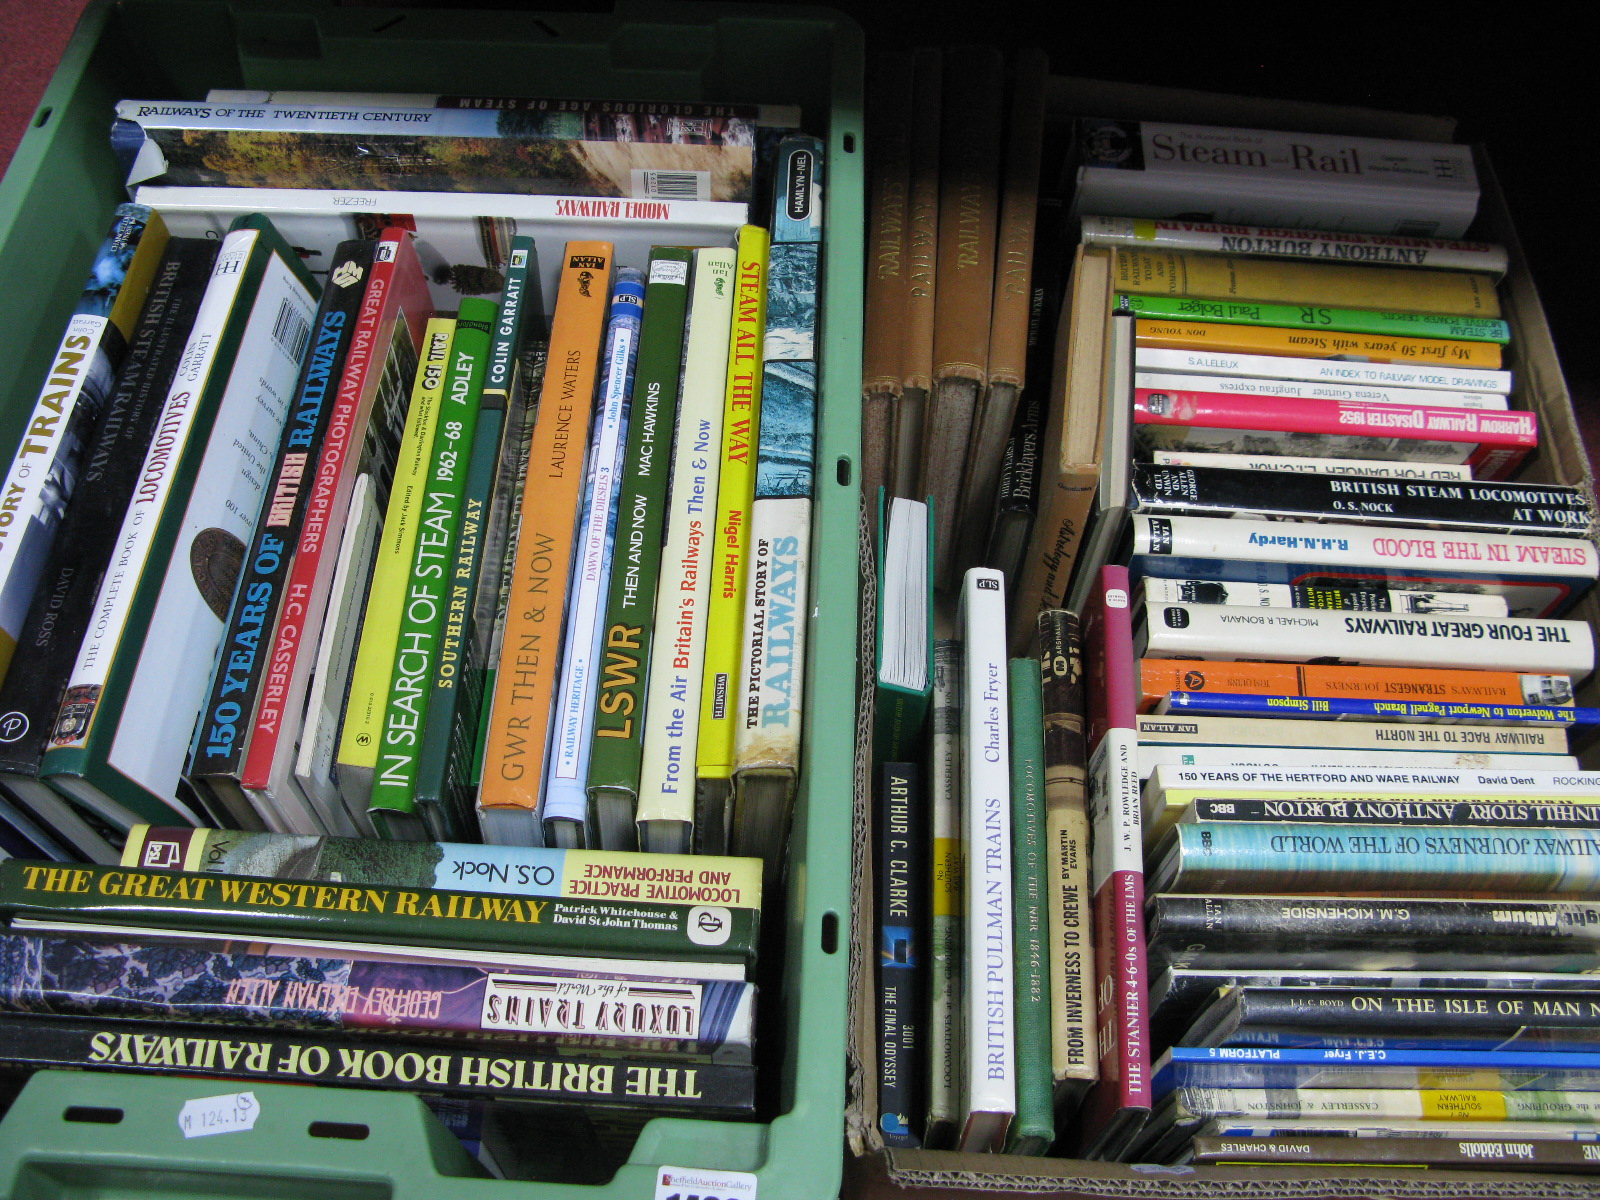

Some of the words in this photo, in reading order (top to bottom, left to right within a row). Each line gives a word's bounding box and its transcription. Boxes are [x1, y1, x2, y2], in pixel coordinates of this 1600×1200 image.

[137, 106, 212, 119] RAILWAYS
[215, 108, 236, 118] OF
[237, 109, 265, 119] THE
[273, 109, 359, 121] TWENTIETH
[362, 111, 432, 122] CENTURY
[794, 153, 807, 213] HAMLYN-NEL
[555, 200, 621, 219] RAILWAYS
[622, 200, 670, 220] MODEL
[1219, 236, 1313, 259] BURTON
[1318, 242, 1428, 267] ANTHONY
[361, 278, 385, 327] GREAT
[738, 261, 760, 323] STEAM
[734, 328, 755, 366] ALL
[1287, 334, 1328, 348] Steam
[1330, 339, 1359, 353] with
[1362, 340, 1397, 355] years
[1401, 344, 1417, 357] 50
[1420, 344, 1450, 360] first
[1451, 344, 1471, 360] My
[287, 309, 348, 449] RAILWAYS
[342, 331, 375, 402] RAILWAY
[19, 334, 91, 460] TRAINS
[730, 370, 754, 412] THE
[643, 382, 661, 444] HAWKINS
[1338, 409, 1367, 426] 1952
[1366, 410, 1425, 430] DISASTER
[1426, 413, 1479, 433] RAILWAY
[700, 419, 711, 452] Now
[1479, 417, 1536, 436] HARROW
[136, 390, 191, 505] LOCOMOTIVES
[436, 420, 463, 481] 1962-68
[727, 418, 750, 465] WAY
[18, 462, 32, 479] OF
[638, 445, 653, 476] MAC
[692, 452, 708, 470] &
[1012, 433, 1039, 500] Bricklayers
[302, 403, 353, 553] PHOTOGRAPHERS
[687, 474, 706, 515] Then
[1330, 480, 1400, 497] BRITISH
[1406, 483, 1463, 500] STEAM
[1468, 487, 1590, 507] LOCOMOTIVES
[133, 508, 145, 526] OF
[632, 494, 648, 529] NOW
[414, 491, 456, 580] STEAM
[626, 530, 643, 563] AND
[757, 538, 769, 557] OF
[1248, 531, 1349, 551] R.H.N.Hardy
[1371, 537, 1436, 559] BLOOD
[119, 531, 138, 567] BOOK
[253, 533, 285, 575] OF
[680, 520, 702, 592] Railways
[1442, 540, 1483, 561] THE
[1487, 543, 1510, 563] IN
[1516, 545, 1587, 567] STEAM
[528, 532, 556, 594] NOW
[438, 585, 468, 689] SOUTHERN
[456, 497, 483, 581] RAILWAY
[622, 566, 640, 609] THEN
[754, 559, 767, 607] STORY
[93, 570, 124, 640] COMPLETE
[408, 585, 439, 624] OF
[523, 605, 546, 623] &
[220, 581, 273, 698] YEARS
[672, 596, 694, 670] Britain's
[761, 536, 799, 730] RAILWAYS
[1344, 617, 1428, 638] RAILWAYS
[1431, 620, 1485, 639] GREAT
[1486, 623, 1532, 641] FOUR
[1536, 625, 1571, 642] THE
[83, 642, 100, 670] THE
[749, 609, 765, 693] PICTORIAL
[510, 633, 541, 705] THEN
[596, 623, 642, 740] LSWR
[386, 631, 432, 746] SEARCH
[569, 664, 584, 713] HERITAGE
[671, 675, 688, 703] Air
[715, 675, 726, 718] WHSMITH
[746, 695, 760, 730] THE
[1373, 701, 1408, 715] Branch
[1410, 701, 1446, 716] Pagnell
[1448, 702, 1491, 717] Newport
[1493, 706, 1504, 717] to
[1506, 705, 1555, 720] Wolverton
[1557, 709, 1576, 721] The
[204, 701, 241, 759] 150
[564, 715, 578, 758] RAILWAY
[668, 708, 685, 739] the
[1143, 723, 1174, 733] ALLAN
[1178, 723, 1196, 733] IAN
[1375, 729, 1415, 742] NORTH
[1418, 729, 1440, 743] THE
[1442, 730, 1456, 743] TO
[500, 714, 532, 781] GWR
[1460, 730, 1491, 744] RACE
[1494, 731, 1545, 745] RAILWAY
[379, 754, 414, 787] IN
[661, 745, 681, 794] From
[1178, 772, 1198, 782] 150
[1200, 772, 1236, 782] YEARS
[1238, 772, 1258, 783] OF
[1260, 772, 1283, 783] THE
[1285, 773, 1347, 784] HERTFORD
[1349, 773, 1373, 784] AND
[1375, 774, 1409, 785] WARE
[1411, 774, 1460, 785] RAILWAY
[889, 775, 909, 843] ARTHUR
[1208, 803, 1236, 816] BBC
[1263, 800, 1347, 817] BURTON
[1353, 800, 1455, 819] ANTHONY
[889, 839, 908, 854] C.
[985, 797, 1002, 874] TRAINS
[1270, 834, 1346, 854] WORLD
[1348, 835, 1391, 854] THE
[1393, 835, 1421, 854] OF
[1424, 834, 1533, 856] JOURNEYS
[584, 864, 694, 882] PERFORMANCE
[698, 871, 731, 886] AND
[1124, 873, 1135, 899] LMS
[23, 867, 93, 893] THE
[99, 871, 214, 901] GREAT
[219, 880, 388, 914] WESTERN
[392, 890, 549, 924] RAILWAY
[569, 880, 640, 899] PRACTICE
[646, 884, 741, 903] LOCOMOTIVE
[889, 859, 909, 918] CLARKE
[554, 903, 598, 915] Patrick
[600, 906, 667, 920] Whitehouse
[668, 911, 679, 920] &
[1063, 884, 1080, 927] CREWE
[1125, 900, 1136, 926] THE
[1281, 906, 1374, 920] KICHENSIDE
[552, 913, 586, 925] David
[587, 915, 601, 926] St
[601, 916, 631, 927] John
[631, 918, 678, 931] Thomas
[986, 879, 1003, 983] PULLMAN
[1126, 926, 1137, 942] OF
[1063, 930, 1080, 948] TO
[1124, 945, 1138, 989] 4-6-0s
[883, 986, 897, 1004] THE
[1065, 951, 1082, 1022] INVERNESS
[1350, 996, 1384, 1012] ON
[1391, 997, 1436, 1014] THE
[1444, 998, 1489, 1015] ISLE
[1496, 999, 1524, 1016] OF
[1532, 1000, 1581, 1017] MAN
[884, 1008, 897, 1038] FINAL
[986, 990, 1005, 1081] BRITISH
[1126, 991, 1141, 1059] STANIER
[902, 1024, 915, 1050] 3001
[1067, 1026, 1085, 1065] FROM
[86, 1032, 273, 1072] RAILWAYS
[277, 1043, 330, 1076] OF
[883, 1041, 897, 1088] ODYSSEY
[1208, 1047, 1216, 1058] 5
[1219, 1048, 1280, 1060] PLATFORM
[336, 1048, 452, 1085] BOOK
[457, 1055, 615, 1095] BRITISH
[1129, 1062, 1141, 1096] THE
[624, 1065, 703, 1099] THE
[1247, 1101, 1303, 1112] JOHNSTON
[1320, 1101, 1379, 1111] CASSERLEY
[1437, 1102, 1482, 1111] SOUTHERN
[1220, 1143, 1267, 1153] CHARLES
